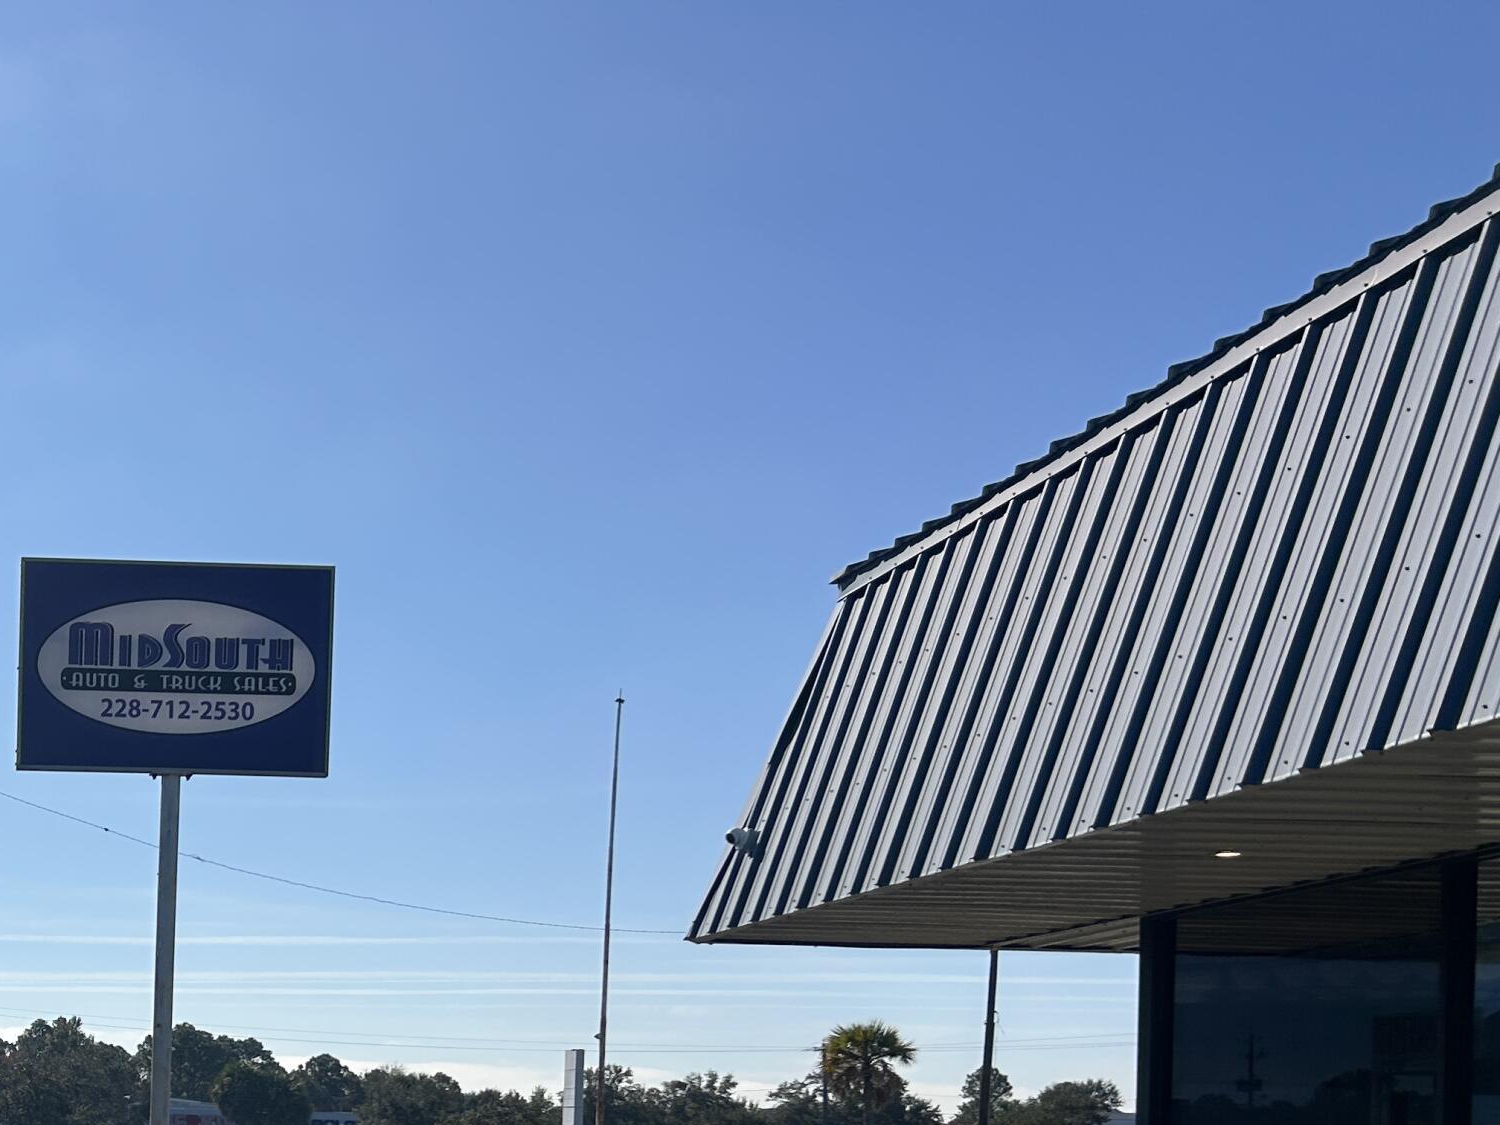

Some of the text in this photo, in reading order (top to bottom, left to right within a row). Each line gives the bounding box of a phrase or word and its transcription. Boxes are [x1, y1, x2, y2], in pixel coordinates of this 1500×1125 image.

[68, 672, 287, 692] AUTO & TRUCK SALES
[100, 698, 255, 721] 228-712-2530
